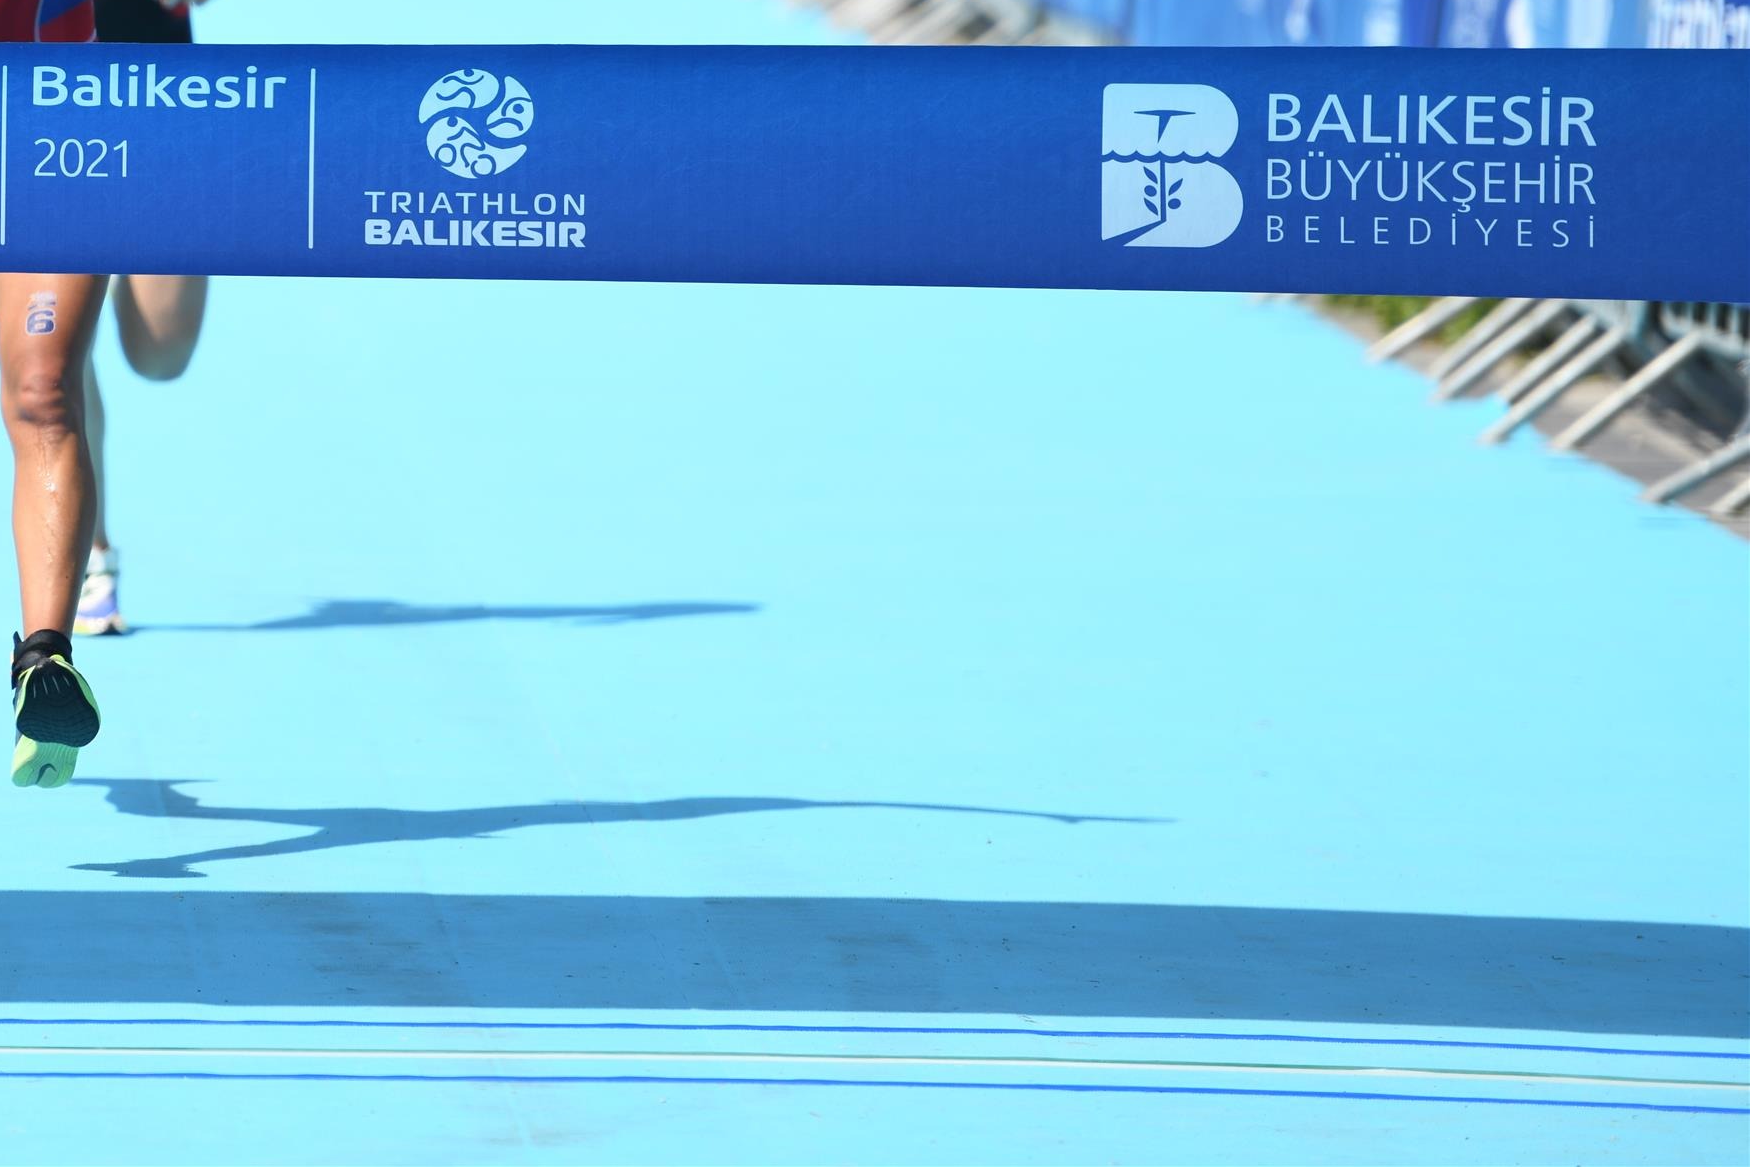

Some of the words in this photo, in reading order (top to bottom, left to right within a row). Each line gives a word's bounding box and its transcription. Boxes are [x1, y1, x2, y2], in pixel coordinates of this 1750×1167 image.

[32, 63, 287, 109] Balikesir
[1268, 86, 1597, 146] BALIKESİR
[34, 138, 128, 178] 2021
[1266, 151, 1597, 213] BÜYÜKŞEHİR
[364, 191, 585, 216] TRIATHLON
[364, 219, 586, 248] BALIKESIR
[1266, 213, 1595, 248] BELEDİYESİ
